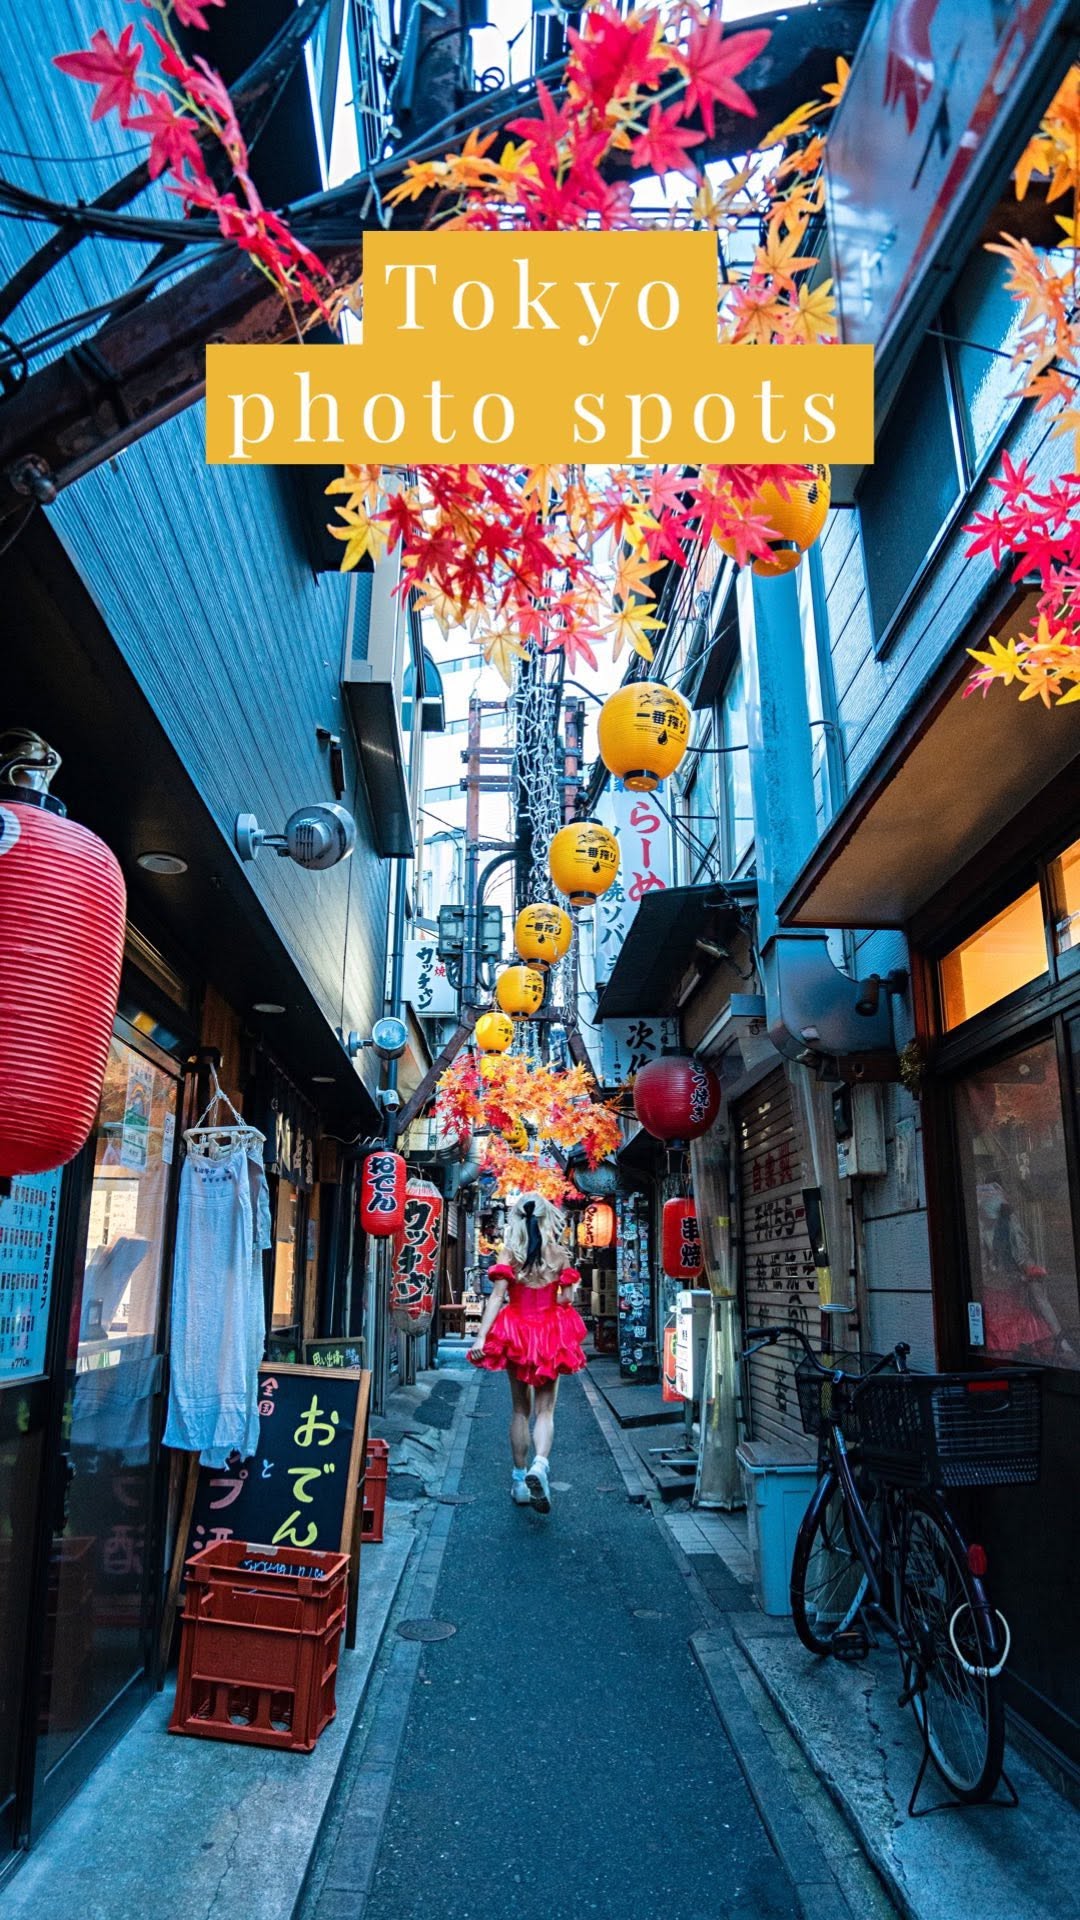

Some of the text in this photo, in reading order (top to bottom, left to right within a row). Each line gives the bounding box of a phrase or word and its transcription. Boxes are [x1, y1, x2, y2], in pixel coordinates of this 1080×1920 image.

[636, 710, 687, 734] 一番搾り
[575, 846, 616, 863] 一番搾り
[416, 946, 434, 1010] ウッチャン
[367, 1156, 397, 1213] おでん
[396, 1200, 432, 1305] ウッチャン
[681, 1216, 701, 1268] 串焼
[261, 1458, 275, 1479] と
[271, 1394, 340, 1548] おでん
